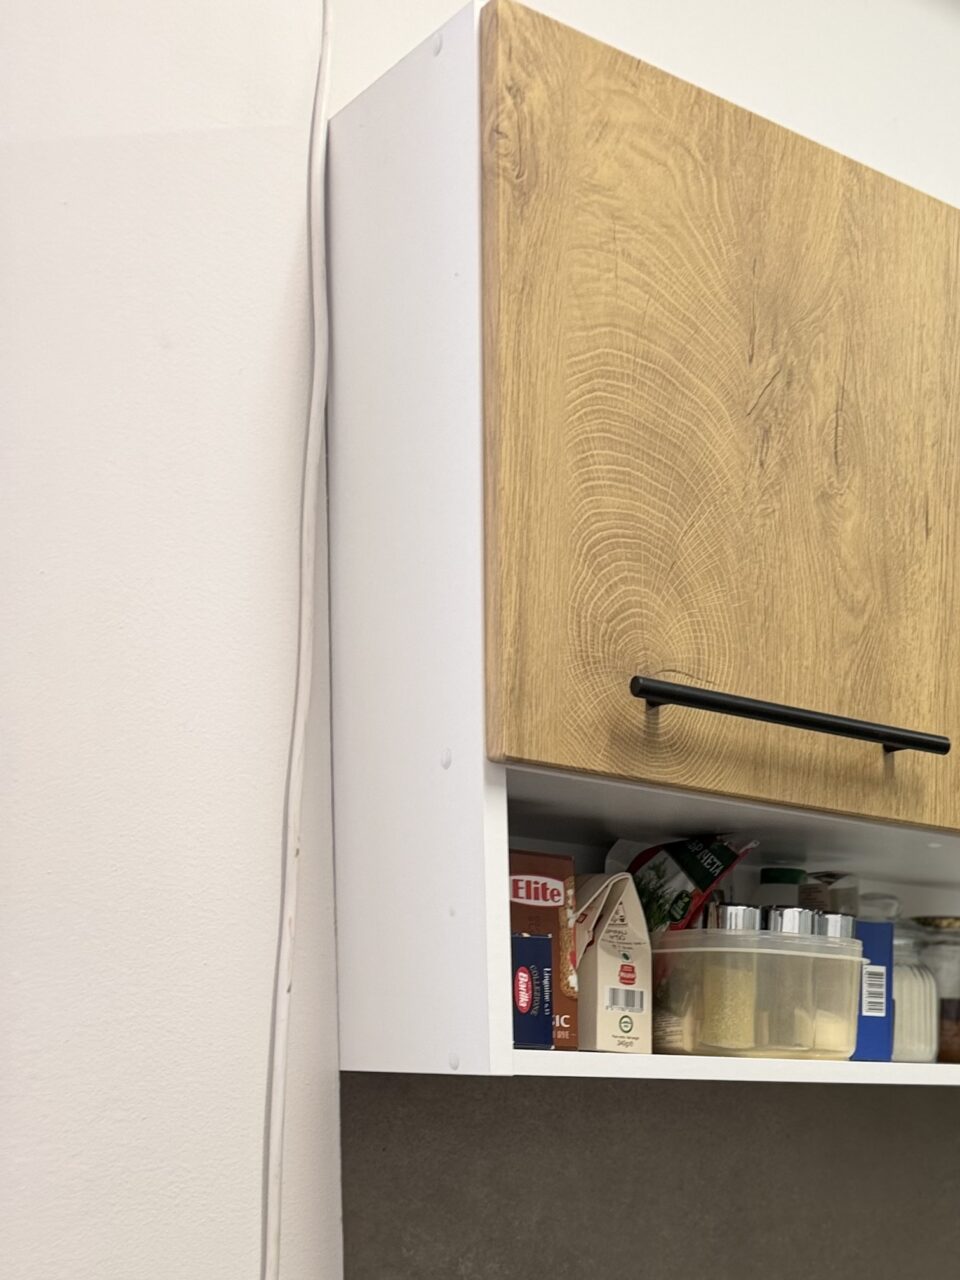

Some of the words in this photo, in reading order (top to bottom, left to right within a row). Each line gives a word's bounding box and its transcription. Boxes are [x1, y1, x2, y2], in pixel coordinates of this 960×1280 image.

[511, 878, 562, 903] Elite
[518, 972, 529, 1008] Barilla
[542, 967, 552, 1002] Linguine
